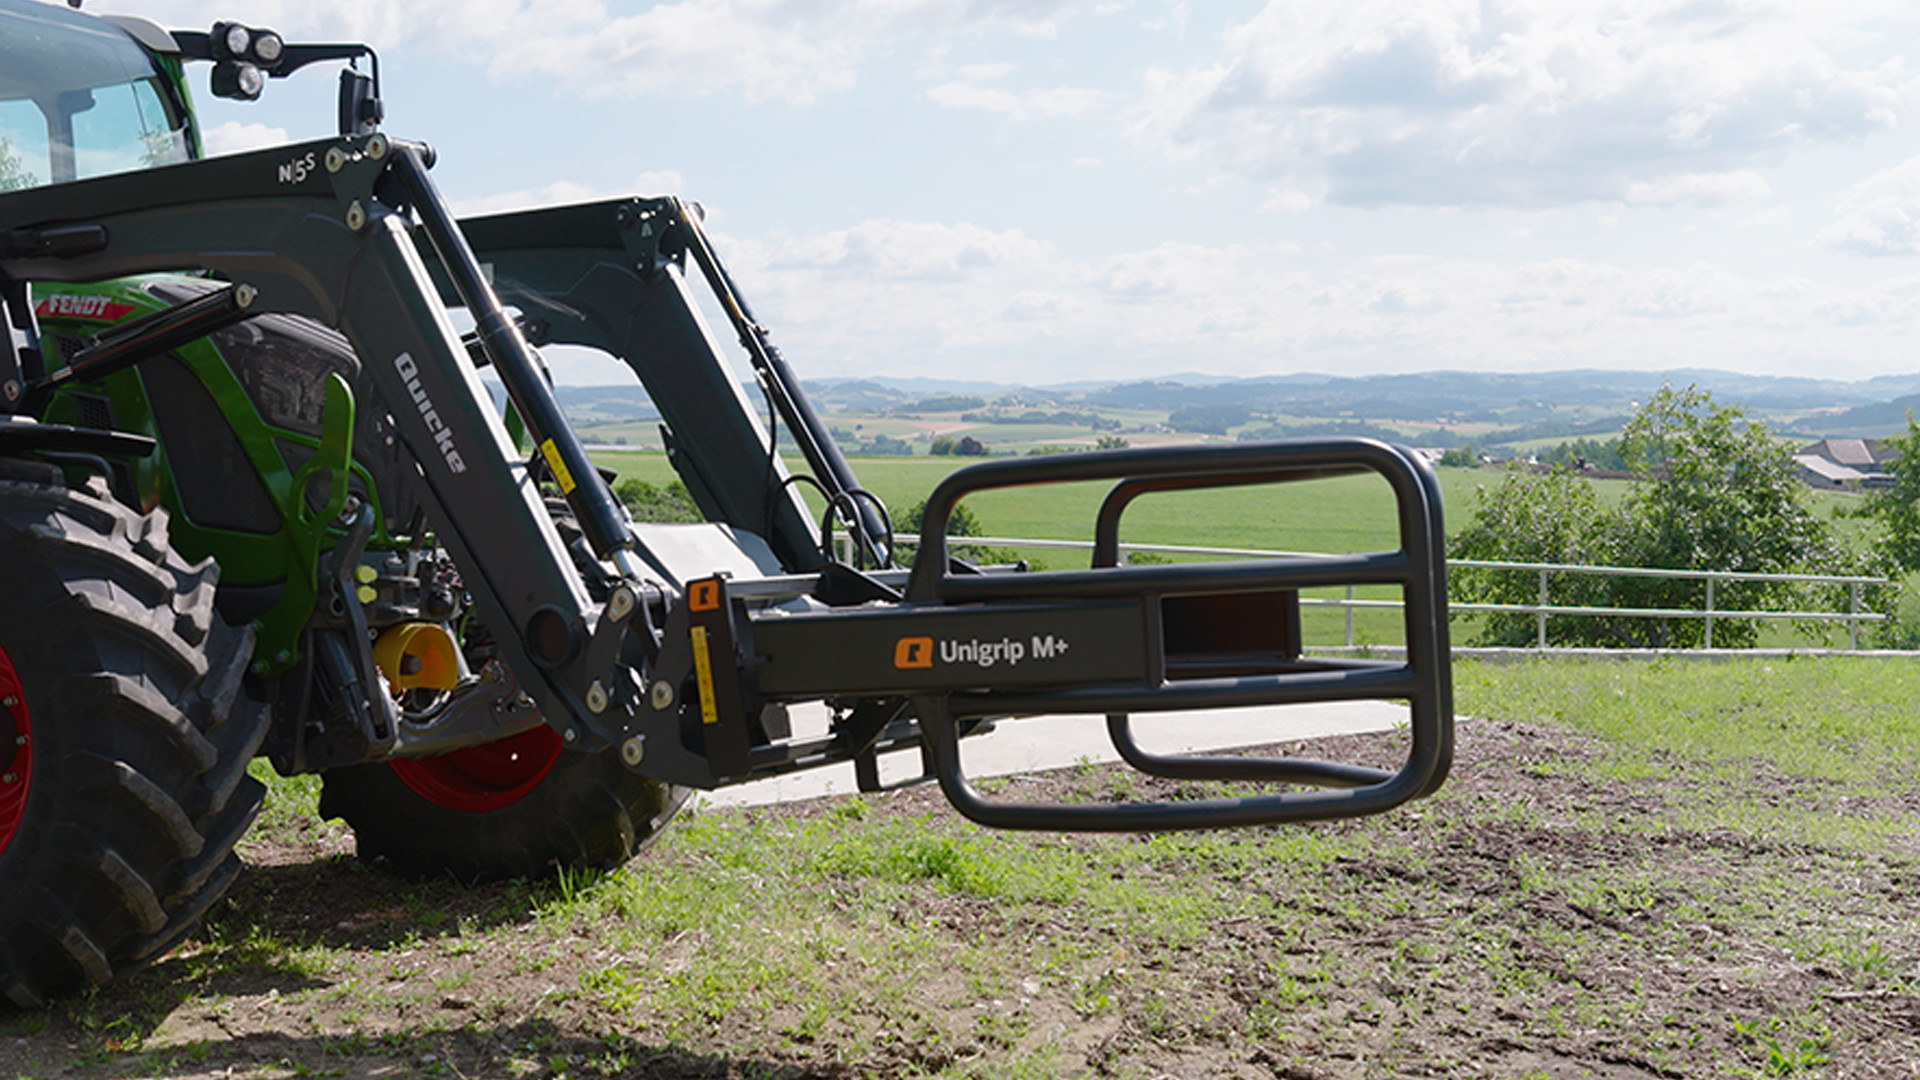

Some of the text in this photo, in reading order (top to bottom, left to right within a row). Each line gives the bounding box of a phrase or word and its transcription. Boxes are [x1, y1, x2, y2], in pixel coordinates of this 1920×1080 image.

[49, 294, 112, 316] FENDT
[393, 352, 467, 473] Quicke
[940, 639, 1025, 667] Unigrip
[1032, 635, 1068, 658] M+
